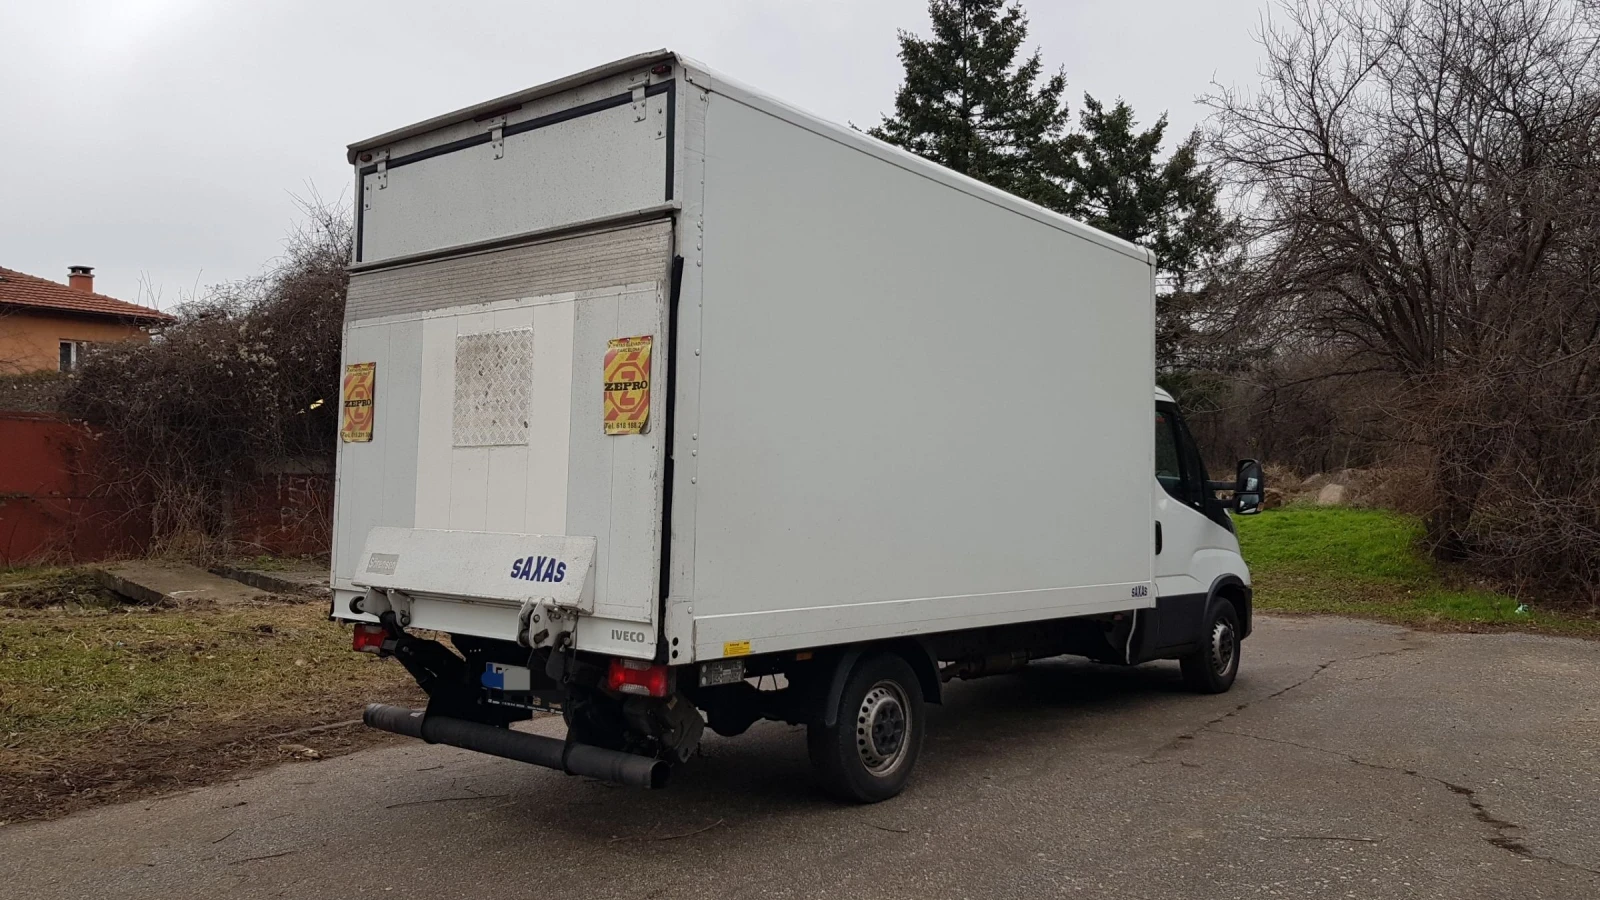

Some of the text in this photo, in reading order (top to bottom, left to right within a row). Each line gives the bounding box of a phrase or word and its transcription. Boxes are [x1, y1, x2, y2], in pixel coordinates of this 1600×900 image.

[604, 381, 648, 391] ZEPRO
[344, 399, 372, 408] ZEPRO
[510, 556, 567, 583] SAXAS
[1131, 585, 1148, 598] SAXAS
[611, 629, 645, 643] IVECO
